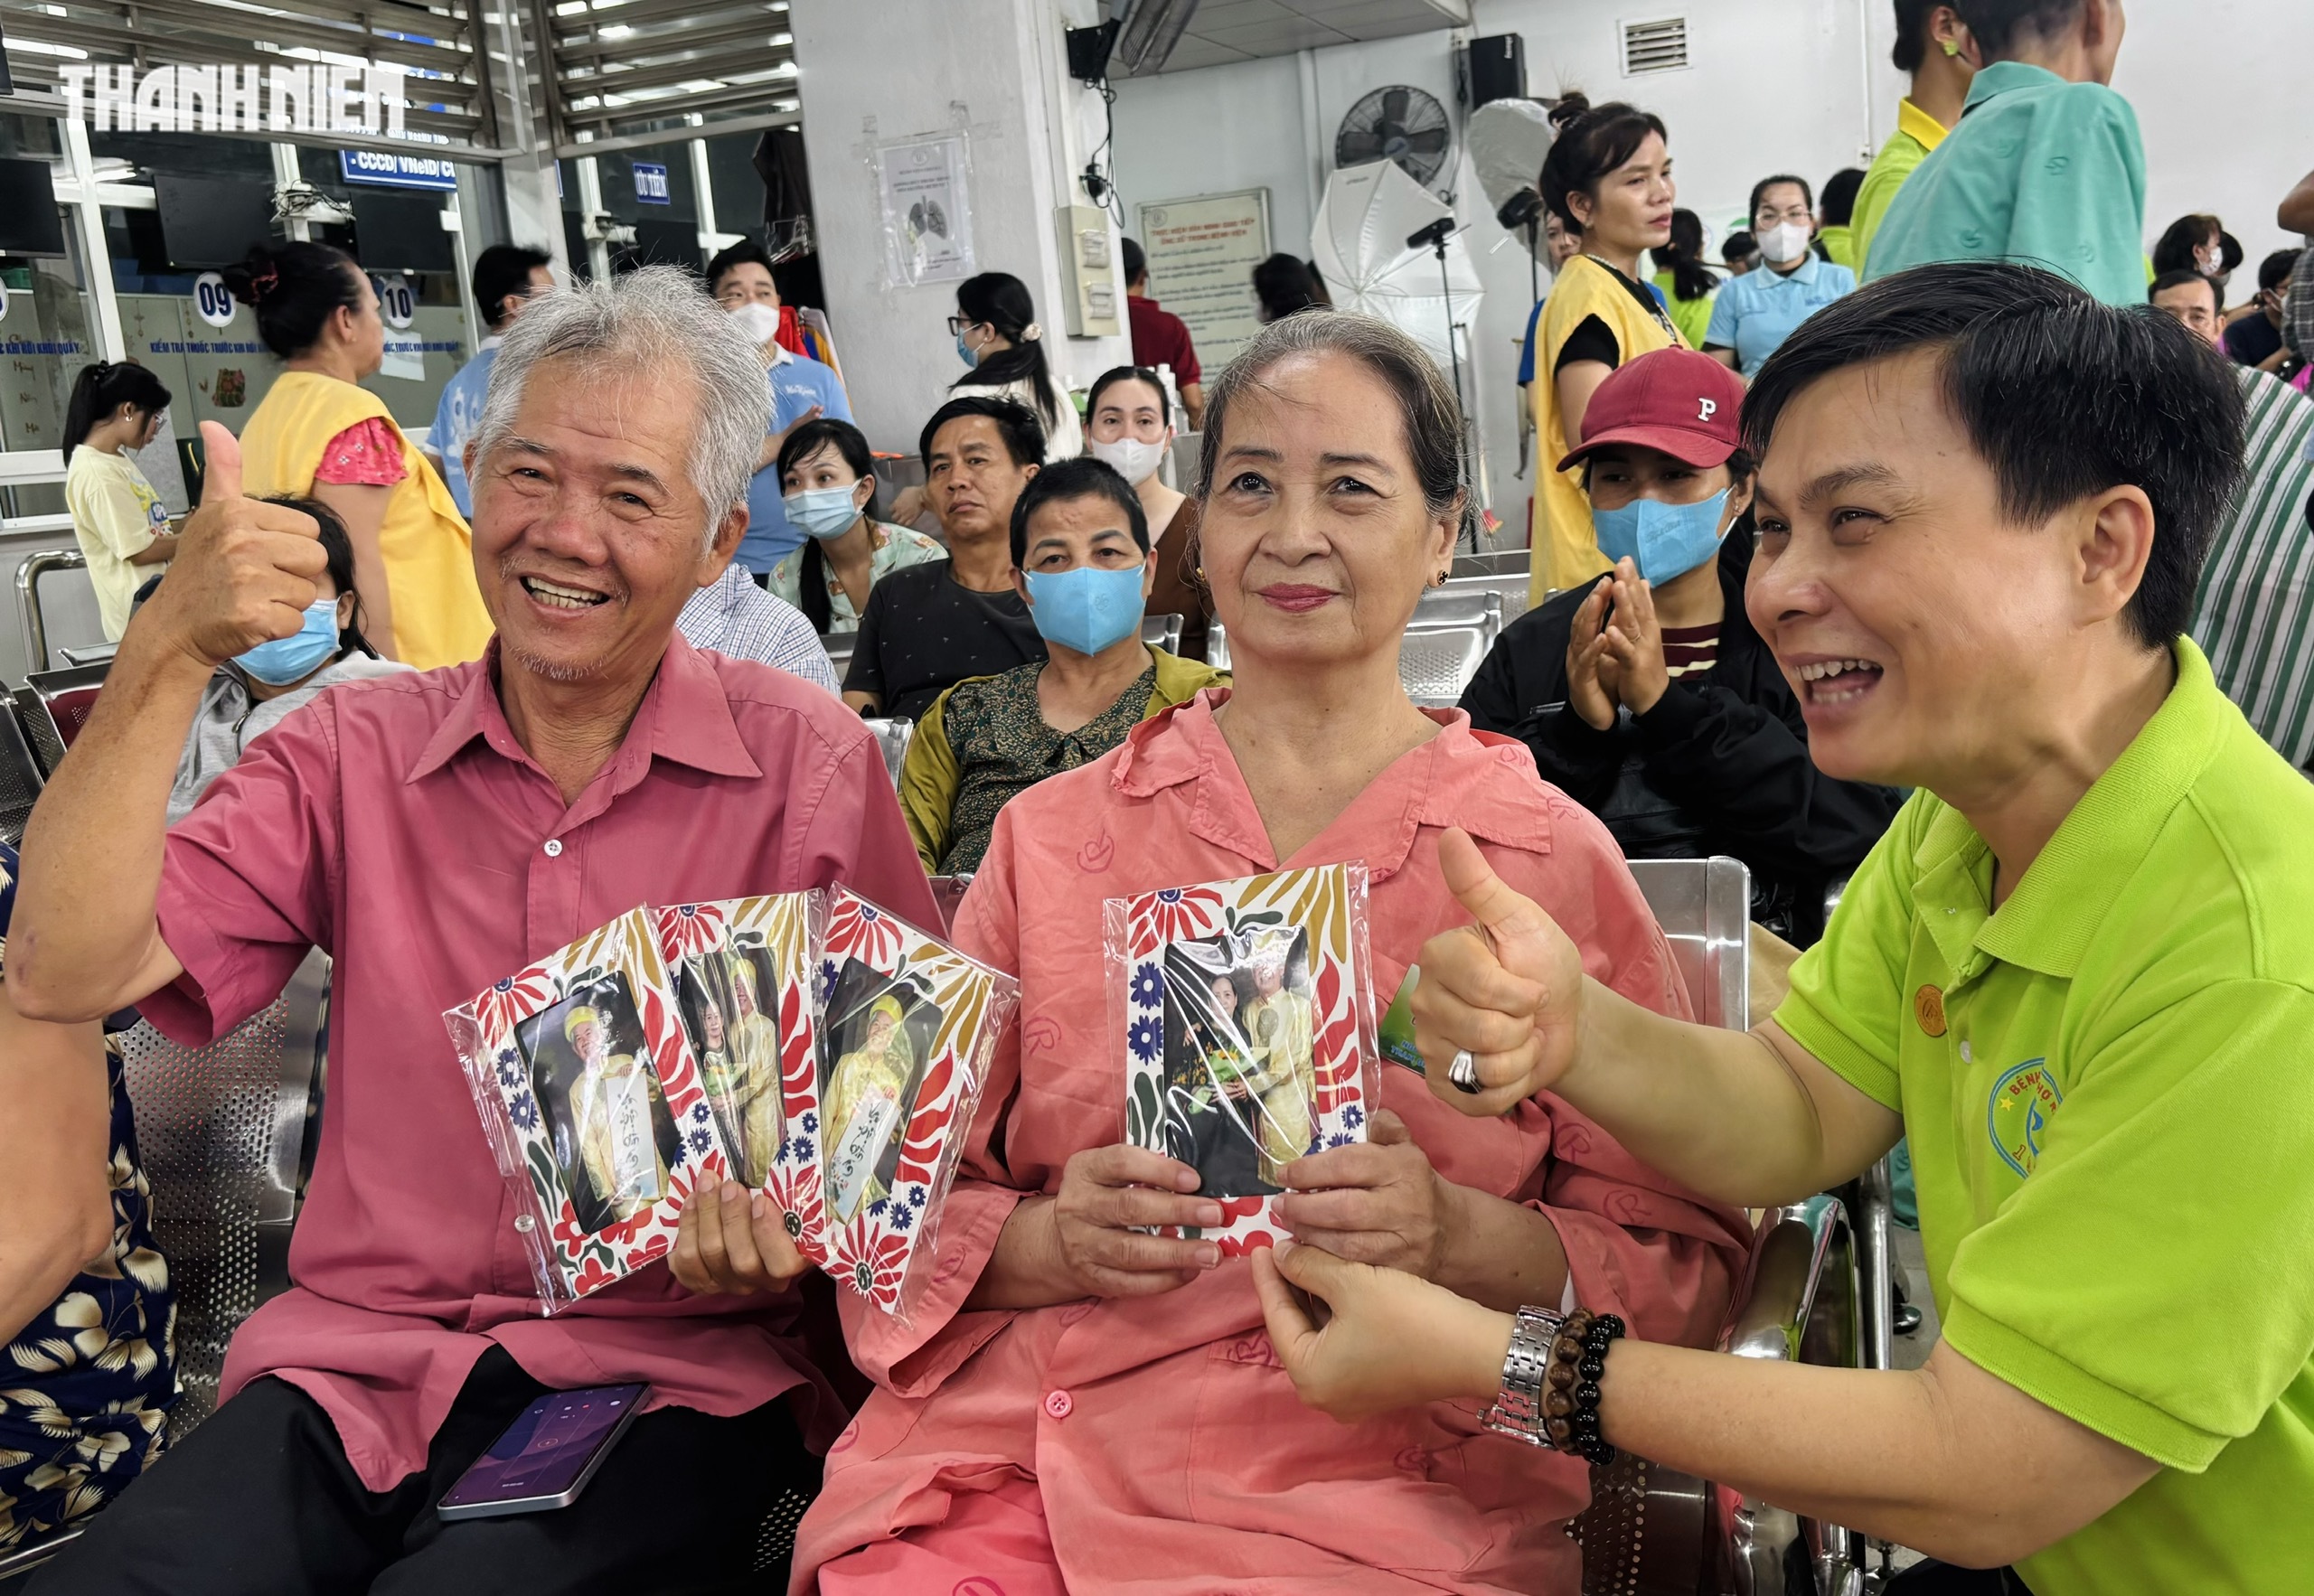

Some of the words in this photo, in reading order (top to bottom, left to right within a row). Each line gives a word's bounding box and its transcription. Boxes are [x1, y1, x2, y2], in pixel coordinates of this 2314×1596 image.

[358, 151, 398, 174] CCCD/
[399, 155, 439, 177] VNeID/
[199, 282, 231, 316] 09
[386, 288, 412, 318] 10
[1698, 398, 1717, 422] P
